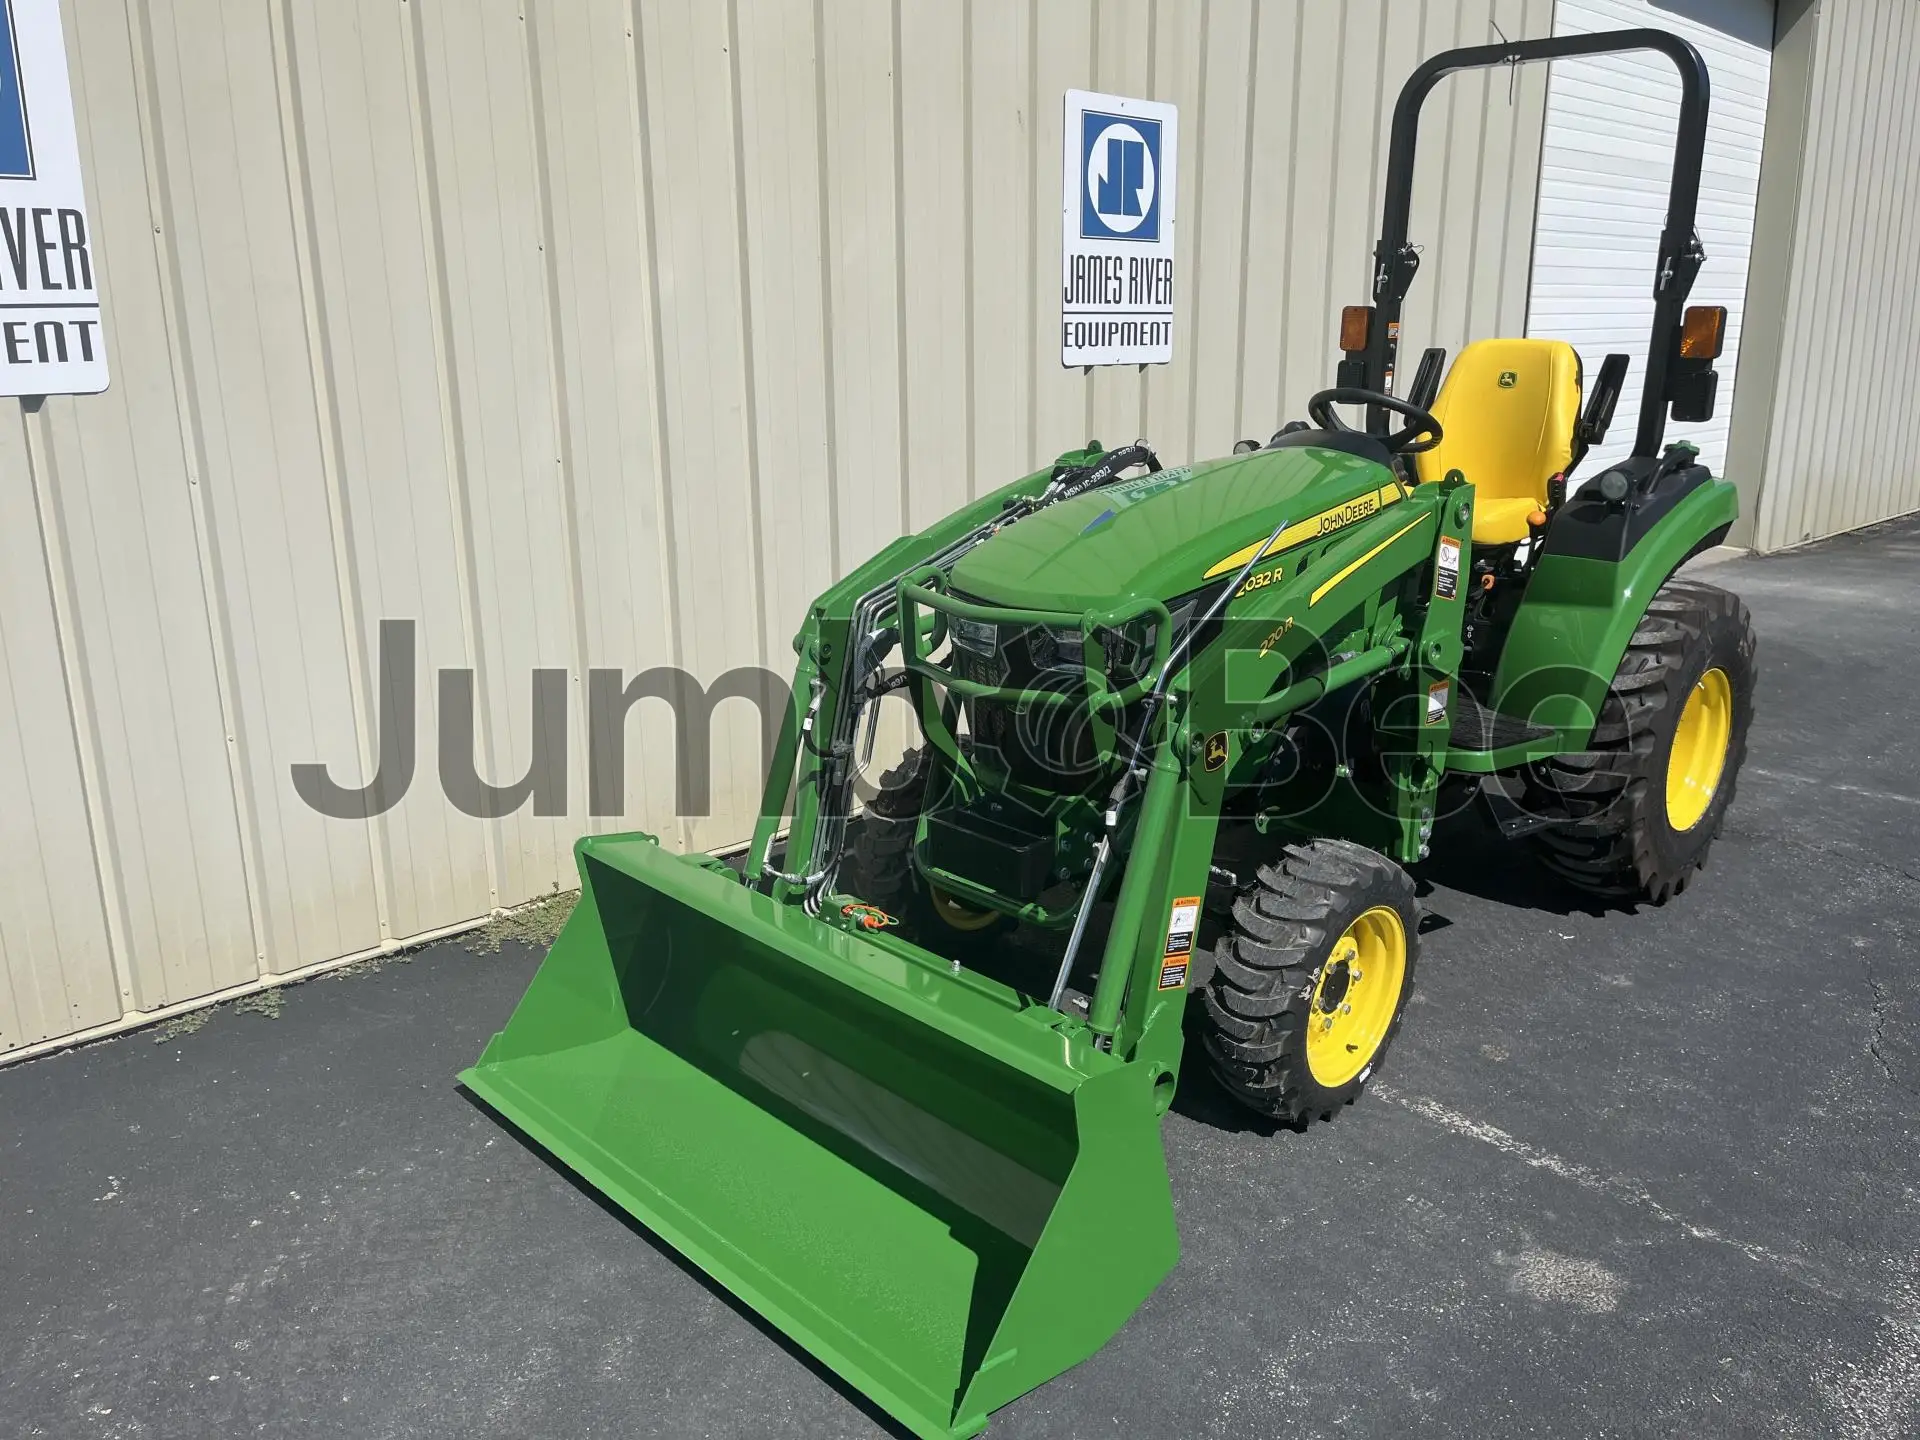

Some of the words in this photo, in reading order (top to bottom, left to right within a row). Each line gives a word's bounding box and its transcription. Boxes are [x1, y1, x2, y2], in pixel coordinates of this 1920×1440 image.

[0, 207, 93, 290] VER
[1064, 254, 1123, 305] JAMES
[1128, 256, 1173, 305] RIVER
[1063, 321, 1172, 350] EQUIPMENT
[1317, 511, 1345, 535] JOHN
[1345, 498, 1375, 523] DEERE
[1273, 567, 1283, 583] R
[1260, 625, 1284, 659] 220
[1285, 616, 1294, 632] R
